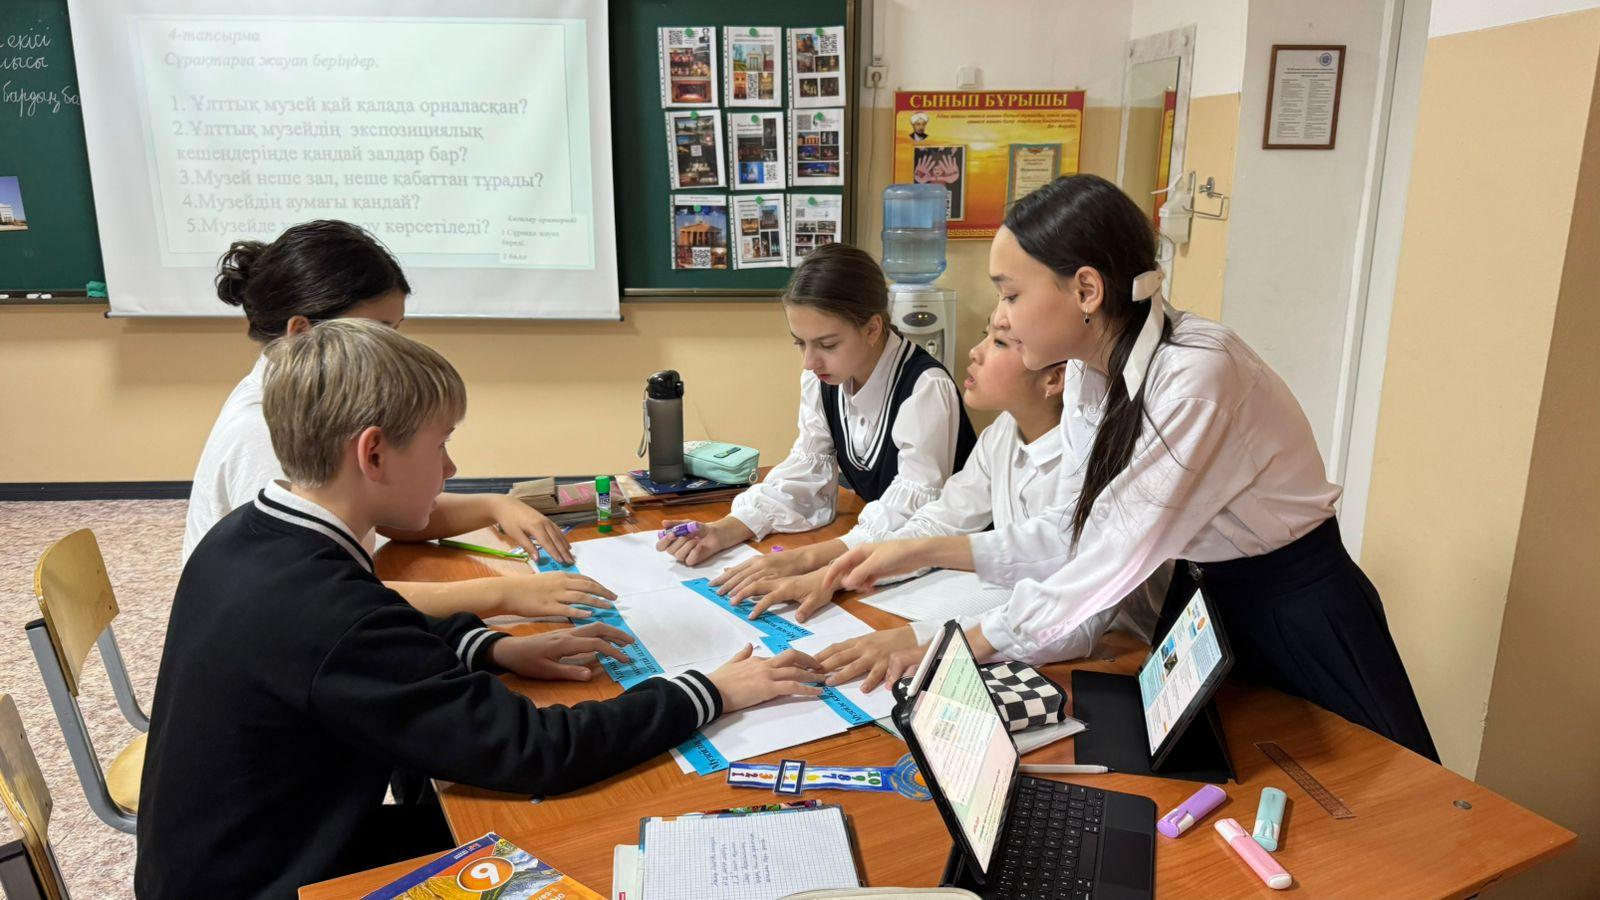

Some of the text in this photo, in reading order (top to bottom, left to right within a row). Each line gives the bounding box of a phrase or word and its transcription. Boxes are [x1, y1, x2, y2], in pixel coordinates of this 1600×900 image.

[168, 29, 260, 45] 4-тапсырма
[164, 52, 380, 71] Сұрақтарға жауап беріңдер.
[170, 95, 528, 117] 1. Ұлттық музей қай қалада орналасқан?
[909, 92, 1069, 108] СЫНЫП БҰРЫШЫ
[172, 119, 484, 141] 2.Ұлттық музейдің экспозициялық
[175, 145, 469, 165] кешендерінде қандай залдар бар?
[179, 168, 545, 191] 3.Музей неше зал, неше қабаттан тұрады?
[286, 197, 347, 213] аумағы
[352, 194, 421, 213] қандай?
[186, 217, 277, 236] 5.Музейде
[386, 218, 491, 237] көрсетіледі?
